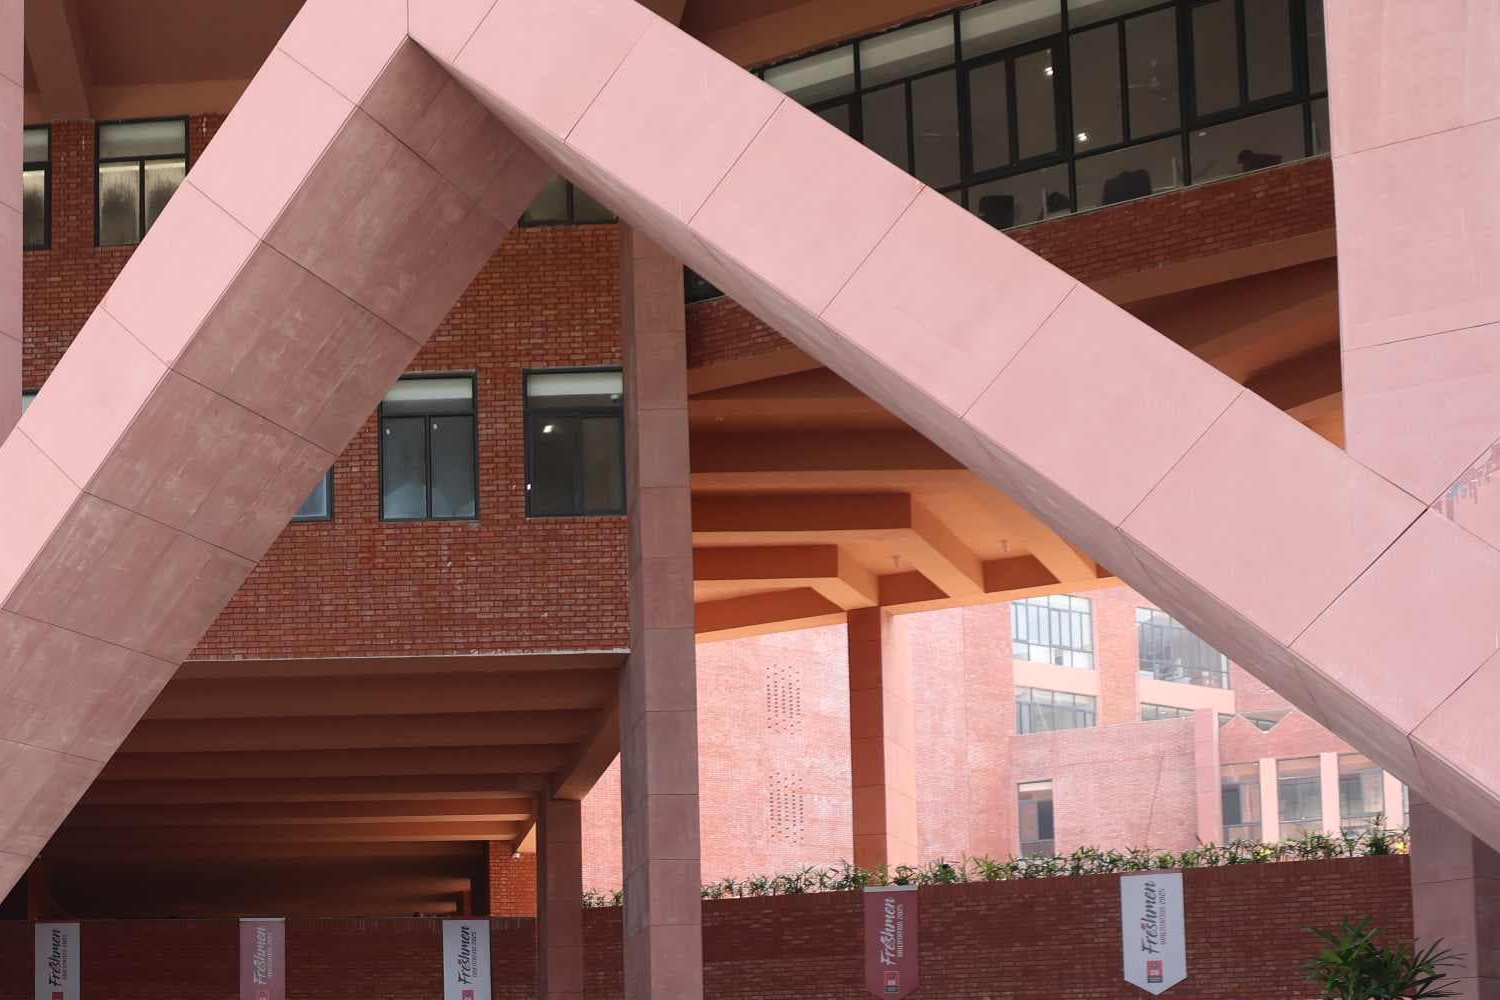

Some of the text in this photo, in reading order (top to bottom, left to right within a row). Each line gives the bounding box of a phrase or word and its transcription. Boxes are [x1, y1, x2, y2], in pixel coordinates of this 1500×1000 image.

[880, 897, 896, 965] Freshmen
[1141, 881, 1159, 954] Freshmen
[49, 929, 62, 986] Freshmen
[458, 926, 472, 984] Freshmen
